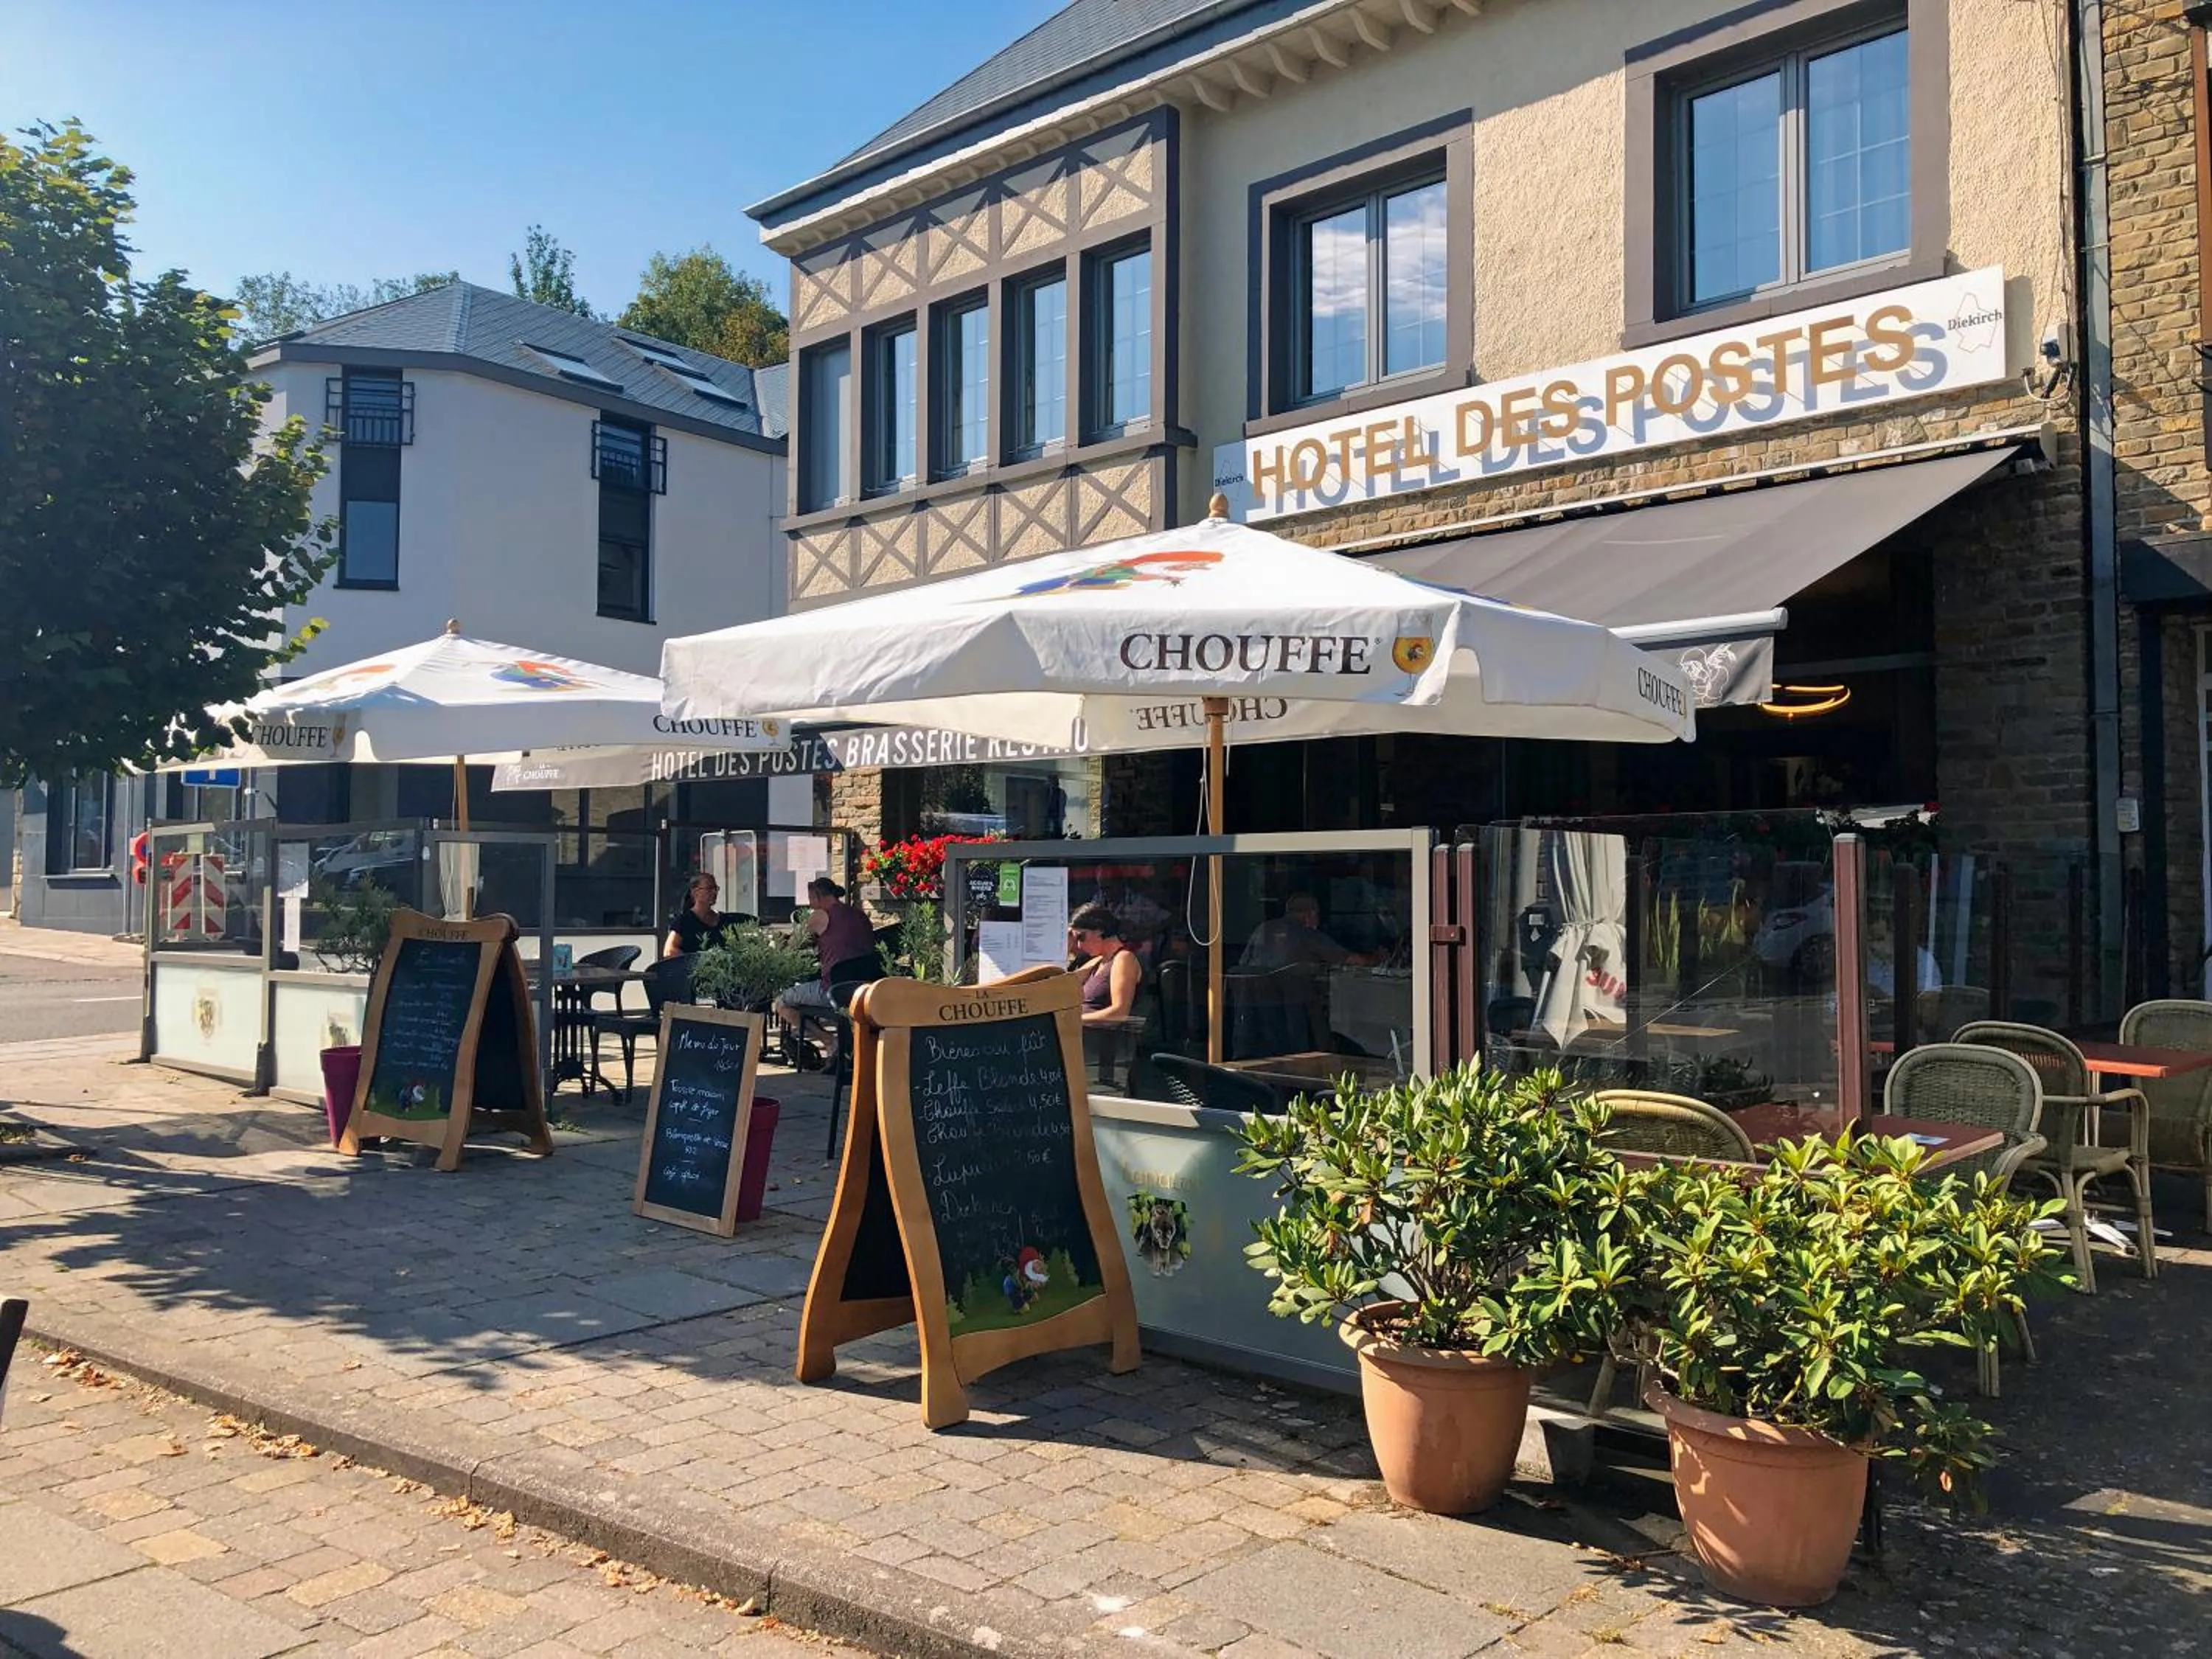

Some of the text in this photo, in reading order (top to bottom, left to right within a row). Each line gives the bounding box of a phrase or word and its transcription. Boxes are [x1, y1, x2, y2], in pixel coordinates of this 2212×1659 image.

[1947, 308, 2003, 332] Diekirch
[1253, 304, 1915, 499] HOTEL DES POSTES
[1119, 633, 1371, 675] CHOUFFE
[652, 751, 707, 781] HOTEL
[714, 751, 750, 777] DES
[845, 728, 978, 768] BRASSERIE
[975, 990, 990, 999] LA
[938, 998, 1029, 1021] CHOUFFE
[678, 1030, 706, 1051] Menu
